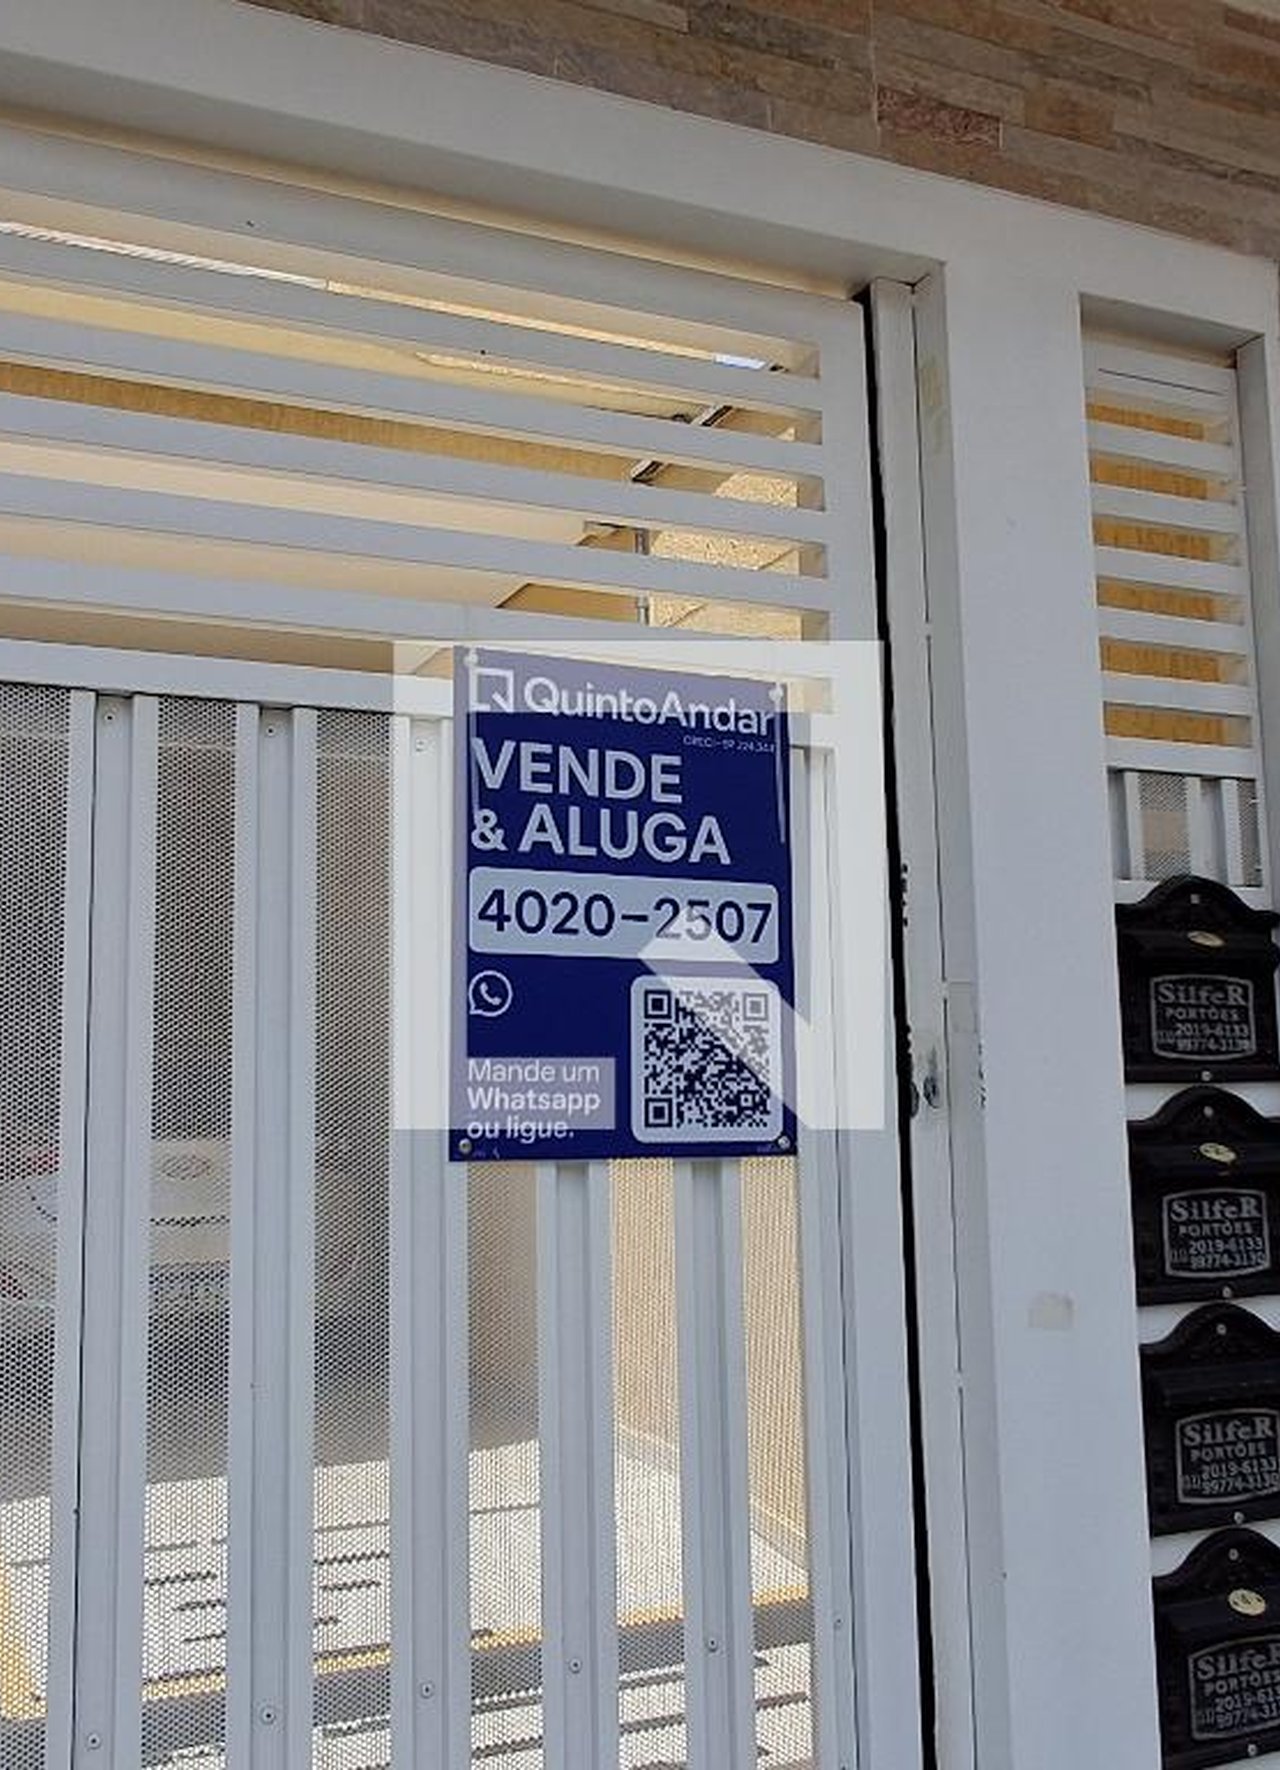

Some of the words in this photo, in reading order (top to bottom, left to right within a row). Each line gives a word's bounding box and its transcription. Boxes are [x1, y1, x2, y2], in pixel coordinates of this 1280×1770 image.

[524, 676, 775, 735] QuintoAndar
[470, 737, 682, 803] VENDE
[470, 809, 508, 850] &
[517, 803, 731, 865] ALUGA
[477, 888, 773, 944] 4020-2507
[468, 1058, 556, 1083] Mande
[563, 1063, 600, 1084] um
[467, 1086, 601, 1117] Whatsapp
[467, 1121, 503, 1139] ou
[506, 1116, 575, 1144] ligue.
